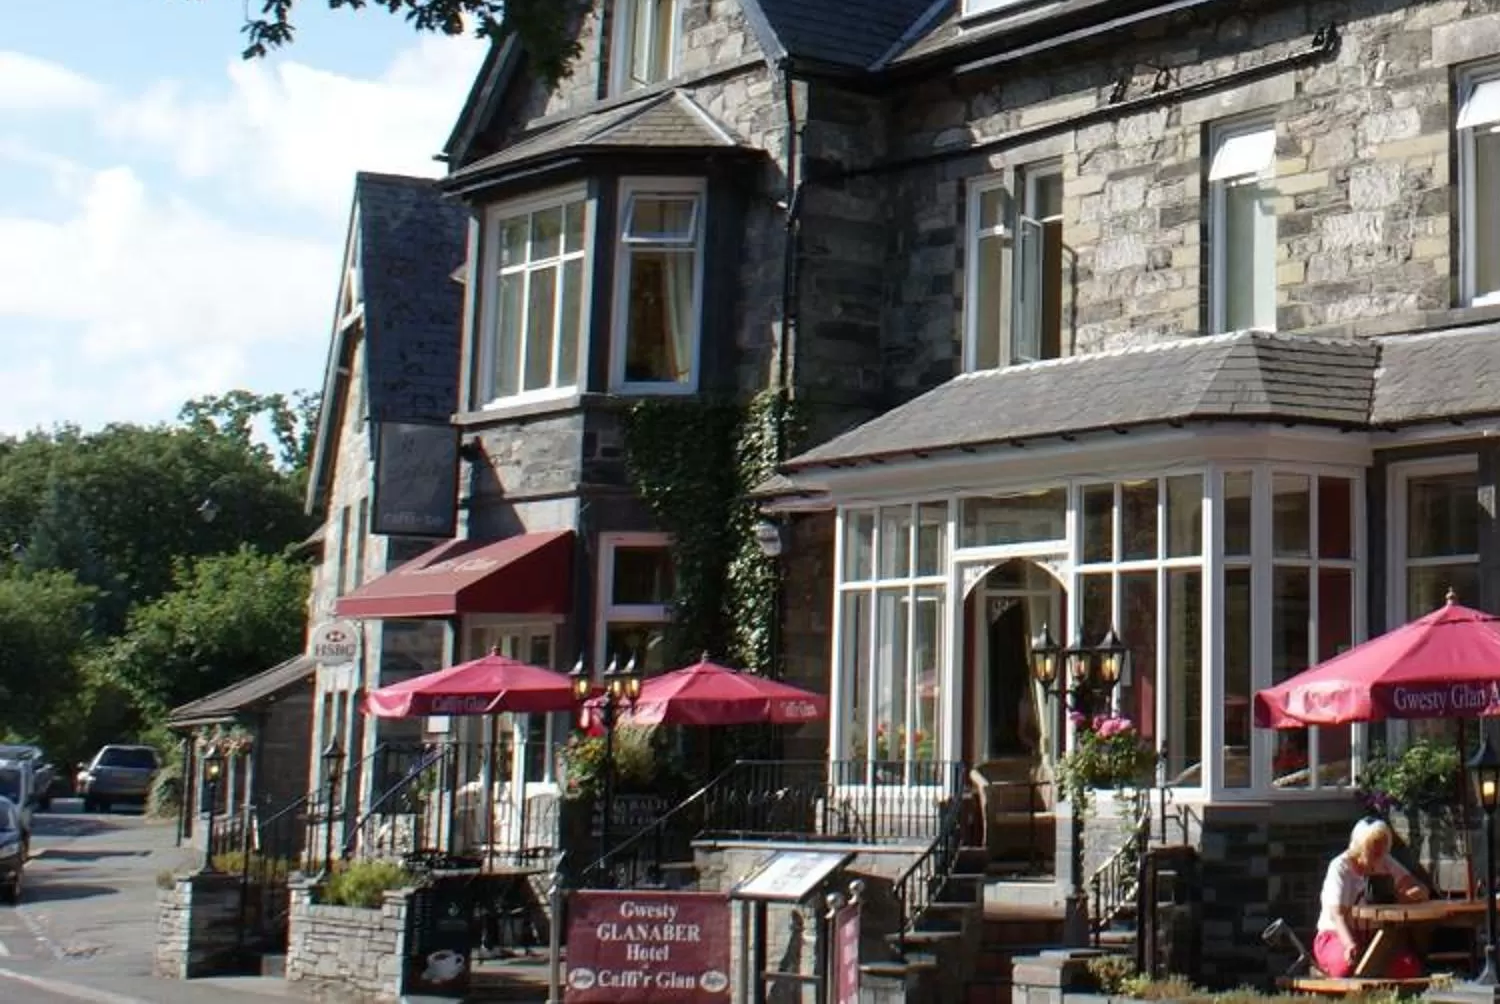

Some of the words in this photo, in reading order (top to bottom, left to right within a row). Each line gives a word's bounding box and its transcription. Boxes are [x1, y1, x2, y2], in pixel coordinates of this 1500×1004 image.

[1394, 686, 1447, 716] Gwesty
[1451, 683, 1486, 709] Glan
[620, 901, 678, 922] Gwesty
[596, 923, 701, 942] GLANABER
[626, 944, 669, 961] Hotel
[655, 971, 696, 989] Glan
